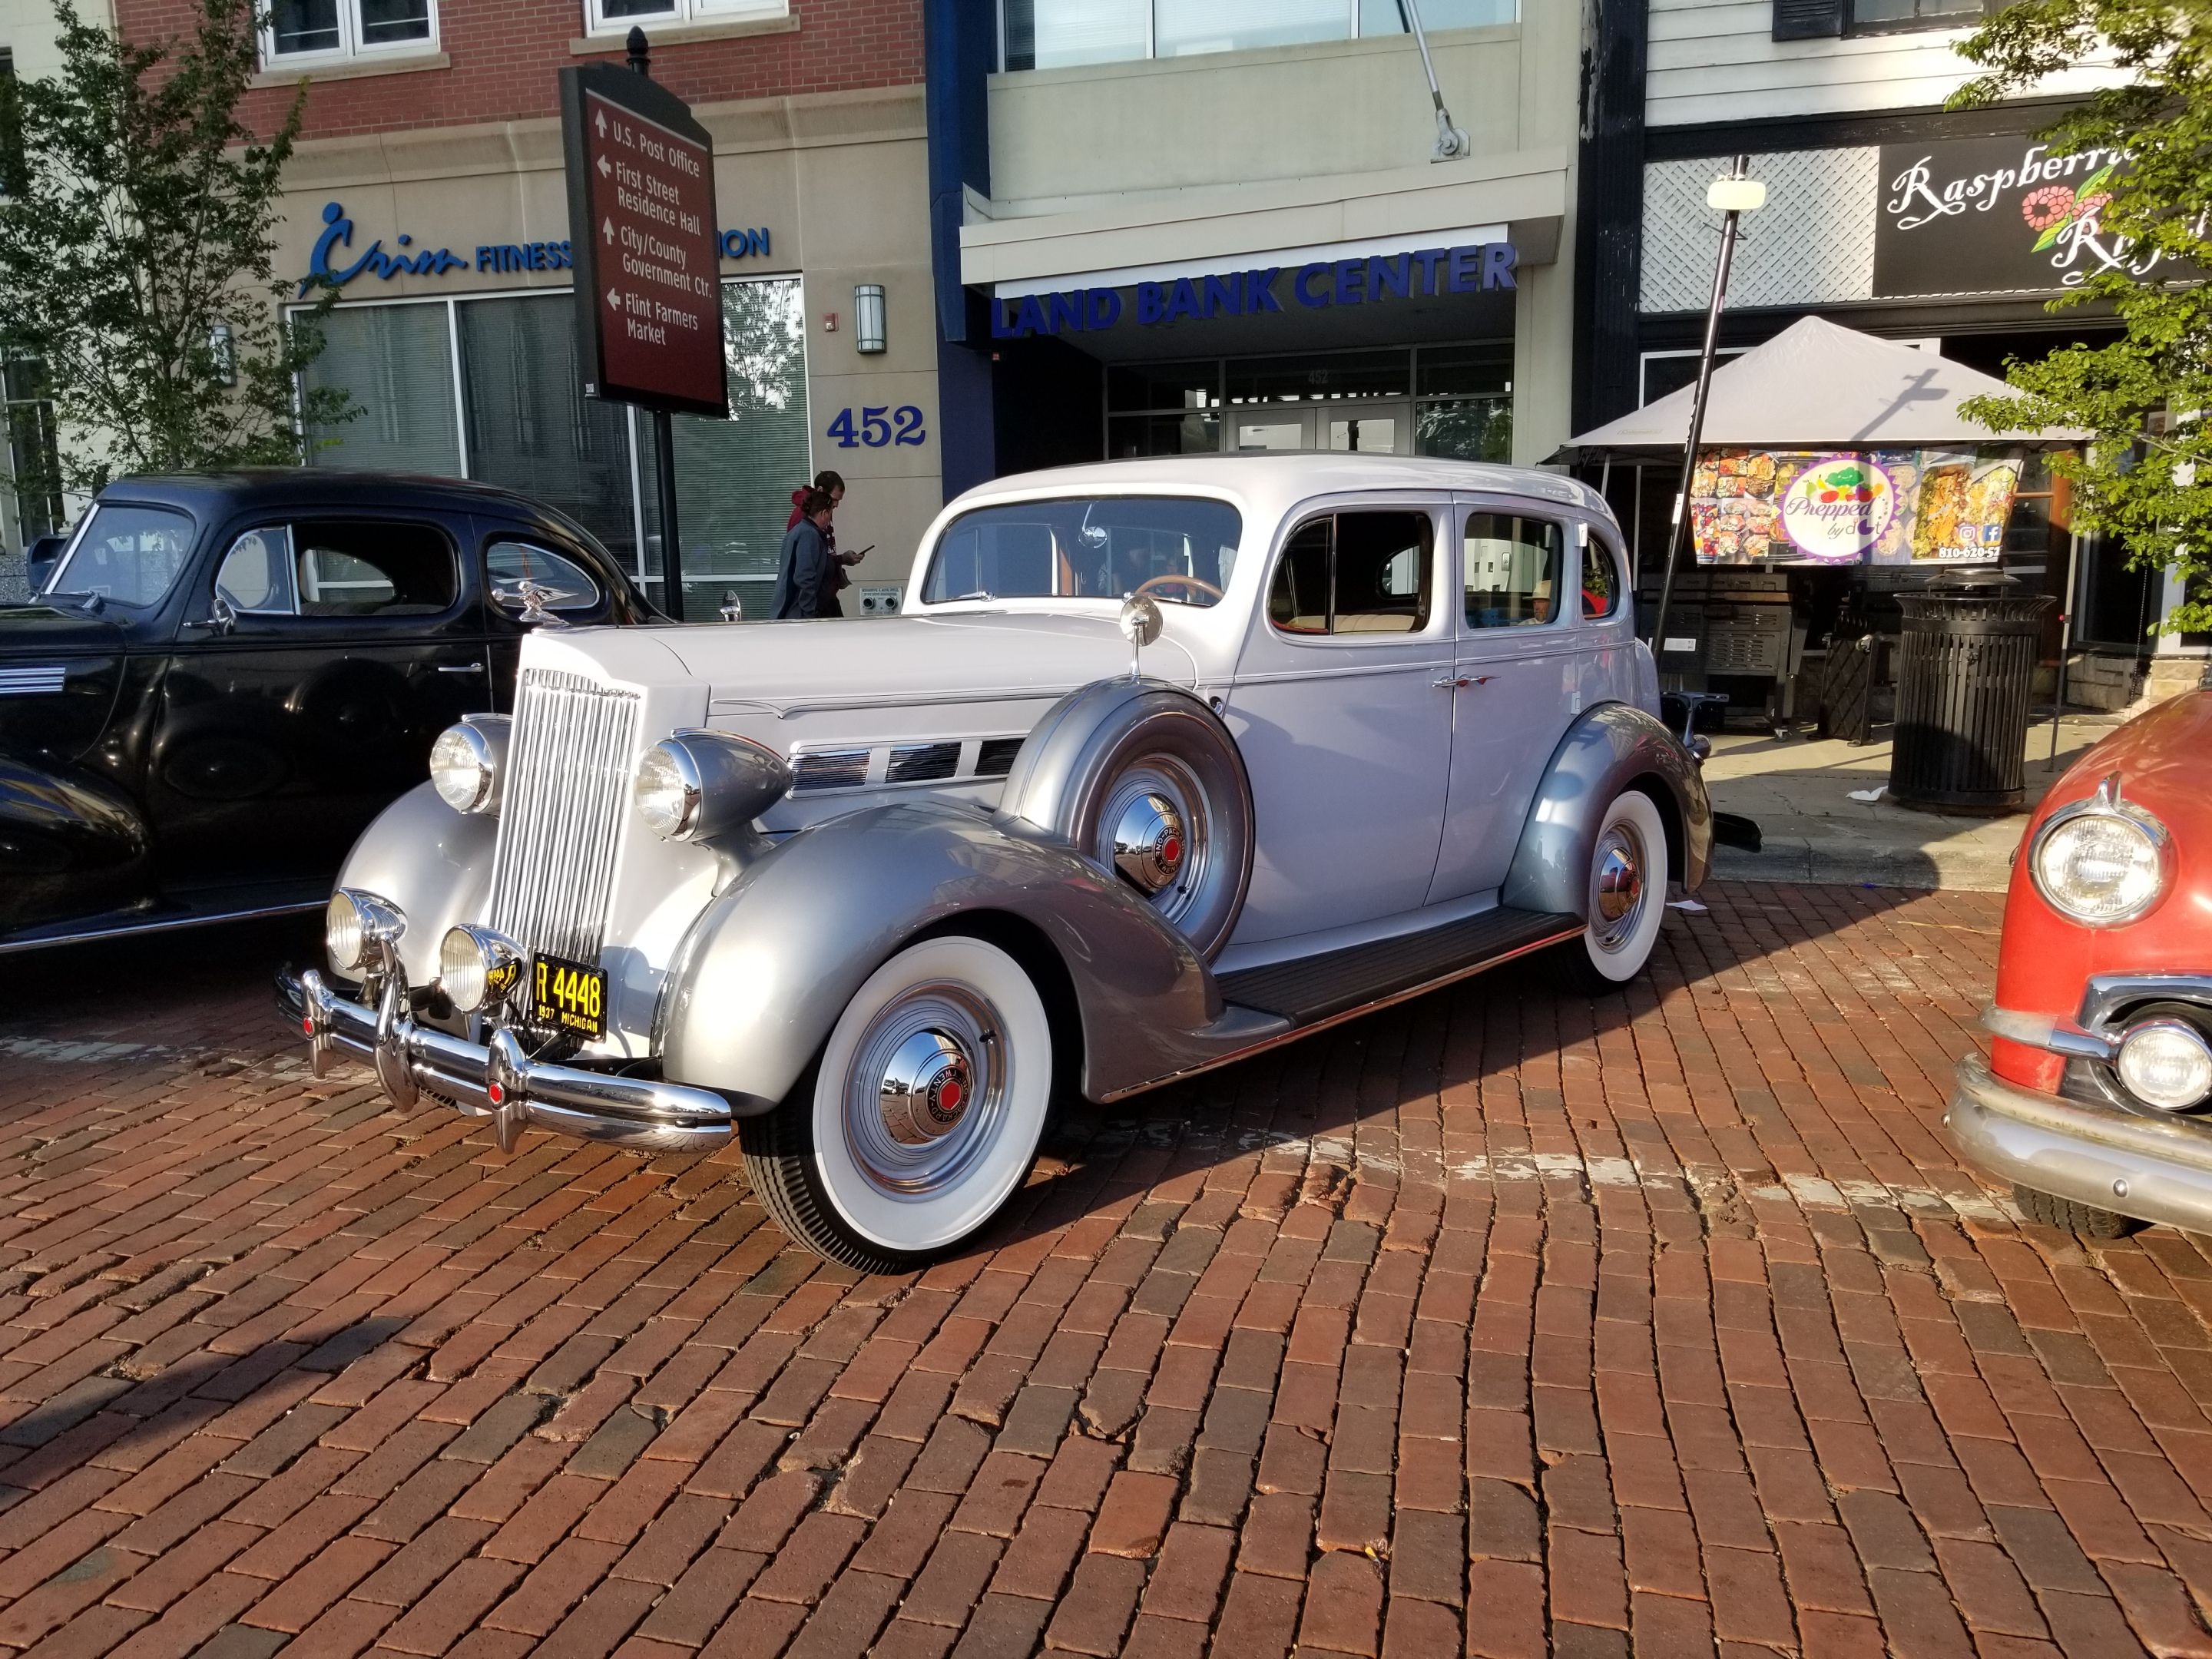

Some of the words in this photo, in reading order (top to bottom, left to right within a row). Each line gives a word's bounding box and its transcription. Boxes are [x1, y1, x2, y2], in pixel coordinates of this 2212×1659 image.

[613, 121, 635, 149] U.S.
[640, 133, 664, 162] Post
[668, 147, 700, 177] Office
[616, 161, 642, 190] First
[646, 174, 680, 205] Street
[618, 186, 675, 226] Residence
[680, 210, 701, 237] Hall
[298, 202, 469, 300] Crim
[475, 240, 572, 273] FITNESS
[621, 226, 687, 270] City/County
[622, 253, 691, 292] Government
[694, 276, 713, 299] Ctr.
[992, 287, 1121, 339] LAND
[1137, 267, 1282, 326] BANK
[1293, 242, 1518, 306] CENTER
[625, 293, 651, 318] Flint
[655, 301, 698, 330] Farmers
[627, 318, 666, 346] Market
[826, 405, 926, 448] 452
[1785, 496, 1874, 526] Prepped
[1827, 522, 1844, 539] by
[537, 962, 548, 1003] R
[554, 967, 601, 1018] 4448
[538, 1005, 555, 1021] 1937
[561, 1012, 598, 1033] MICHIGAN
